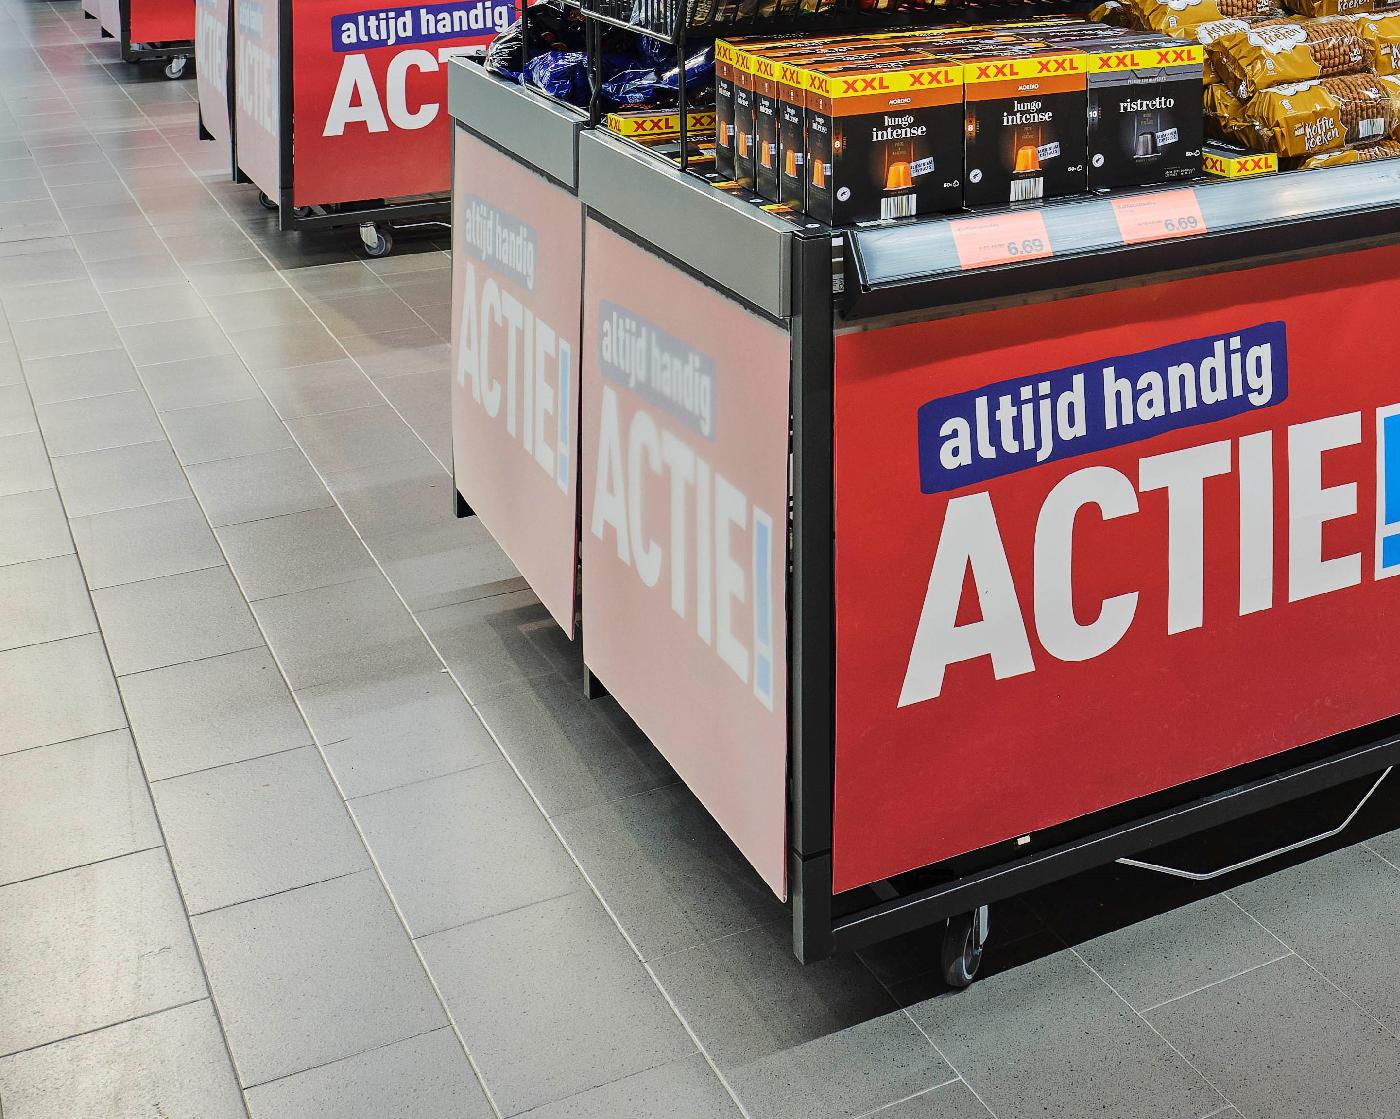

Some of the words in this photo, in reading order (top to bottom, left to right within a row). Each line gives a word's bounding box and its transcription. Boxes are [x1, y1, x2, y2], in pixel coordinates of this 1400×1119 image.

[342, 9, 413, 46] altijd
[420, 0, 509, 35] handig
[716, 44, 733, 62] XXL
[735, 51, 750, 70] XXL
[1098, 54, 1140, 69] XXL
[1157, 48, 1197, 64] XXL
[757, 60, 774, 78] XXL
[782, 66, 801, 85] XXL
[976, 64, 1019, 80] XXL
[1037, 59, 1079, 74] XXL
[809, 74, 829, 94] XXL
[842, 77, 889, 94] XXL
[909, 70, 954, 87] XXL
[1013, 100, 1042, 113] lungo
[1119, 96, 1175, 113] ristretto
[884, 115, 914, 128] lungo
[1002, 111, 1053, 126] intense
[1089, 110, 1098, 119] 10
[633, 118, 674, 133] XXL
[871, 125, 926, 142] intense
[967, 124, 974, 132] 8
[1305, 117, 1336, 136] Koffie
[834, 140, 841, 148] 8
[1305, 127, 1340, 151] koeken
[1163, 214, 1199, 233] 6.69
[464, 201, 493, 263] altijd
[493, 220, 535, 290] handig
[1006, 237, 1044, 257] 6.69
[457, 262, 571, 496] ACTIE!
[601, 313, 646, 388] altijd
[648, 332, 713, 437] handig
[939, 373, 1086, 471] altijd
[1103, 334, 1273, 429] handig
[591, 384, 774, 713] ACTIE!
